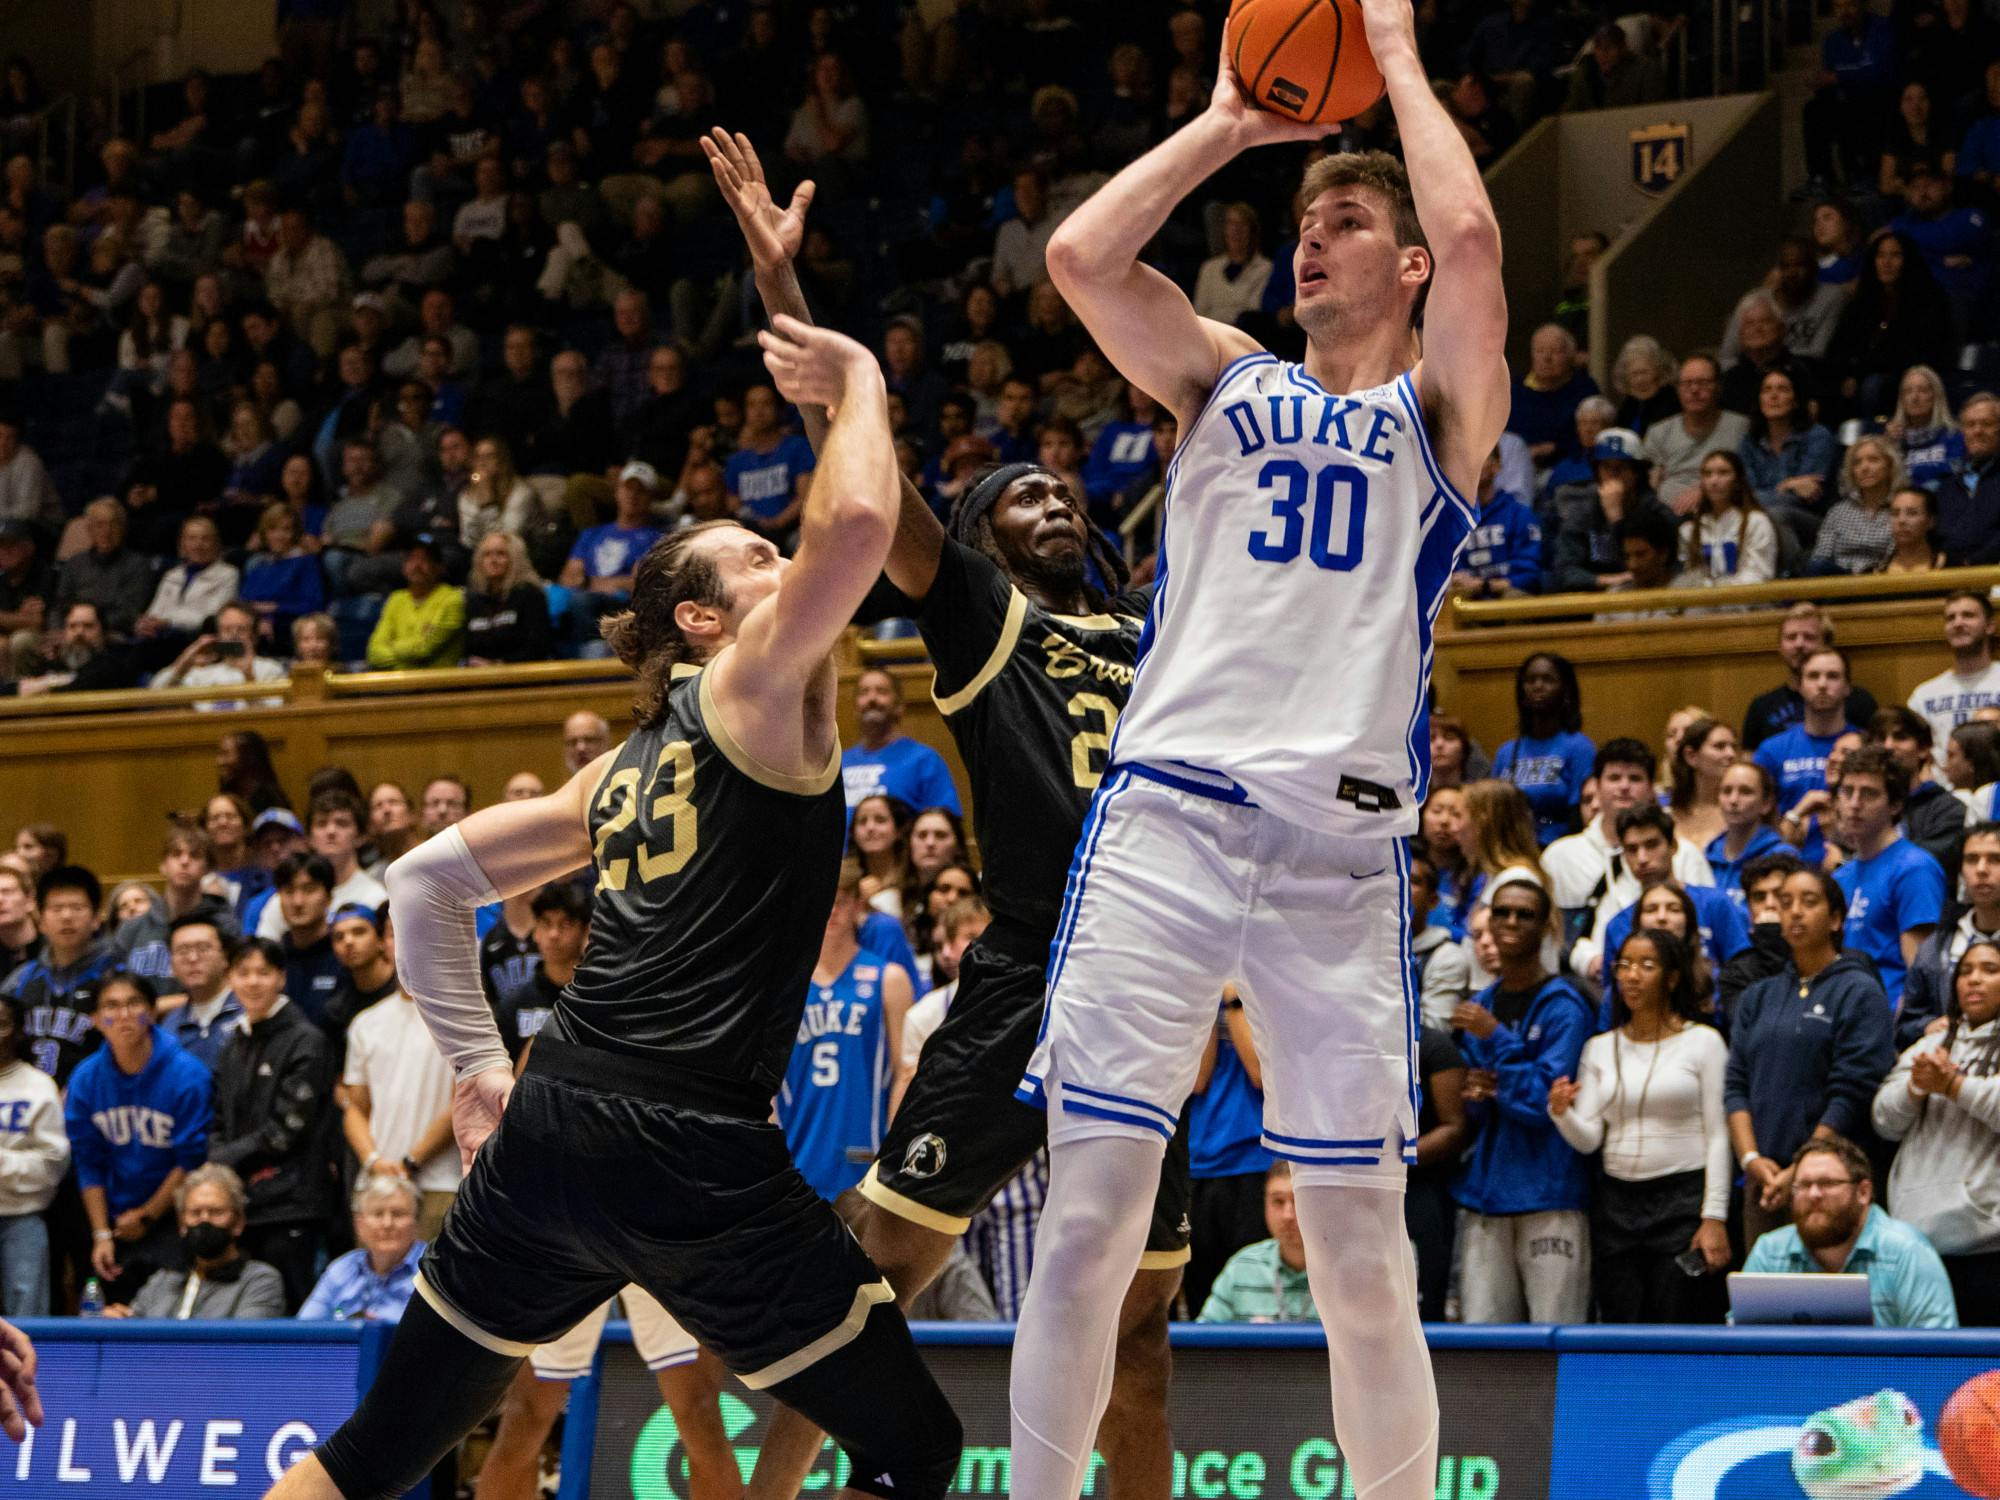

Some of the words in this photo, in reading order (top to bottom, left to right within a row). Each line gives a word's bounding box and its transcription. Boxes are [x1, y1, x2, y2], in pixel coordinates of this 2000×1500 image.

[1641, 141, 1679, 182] 14
[1223, 395, 1402, 465] DUKE
[1247, 459, 1369, 572] 30
[1067, 692, 1119, 789] 2
[593, 740, 699, 896] 23
[811, 1040, 841, 1087] 5
[1529, 1236, 1574, 1259] DUKE
